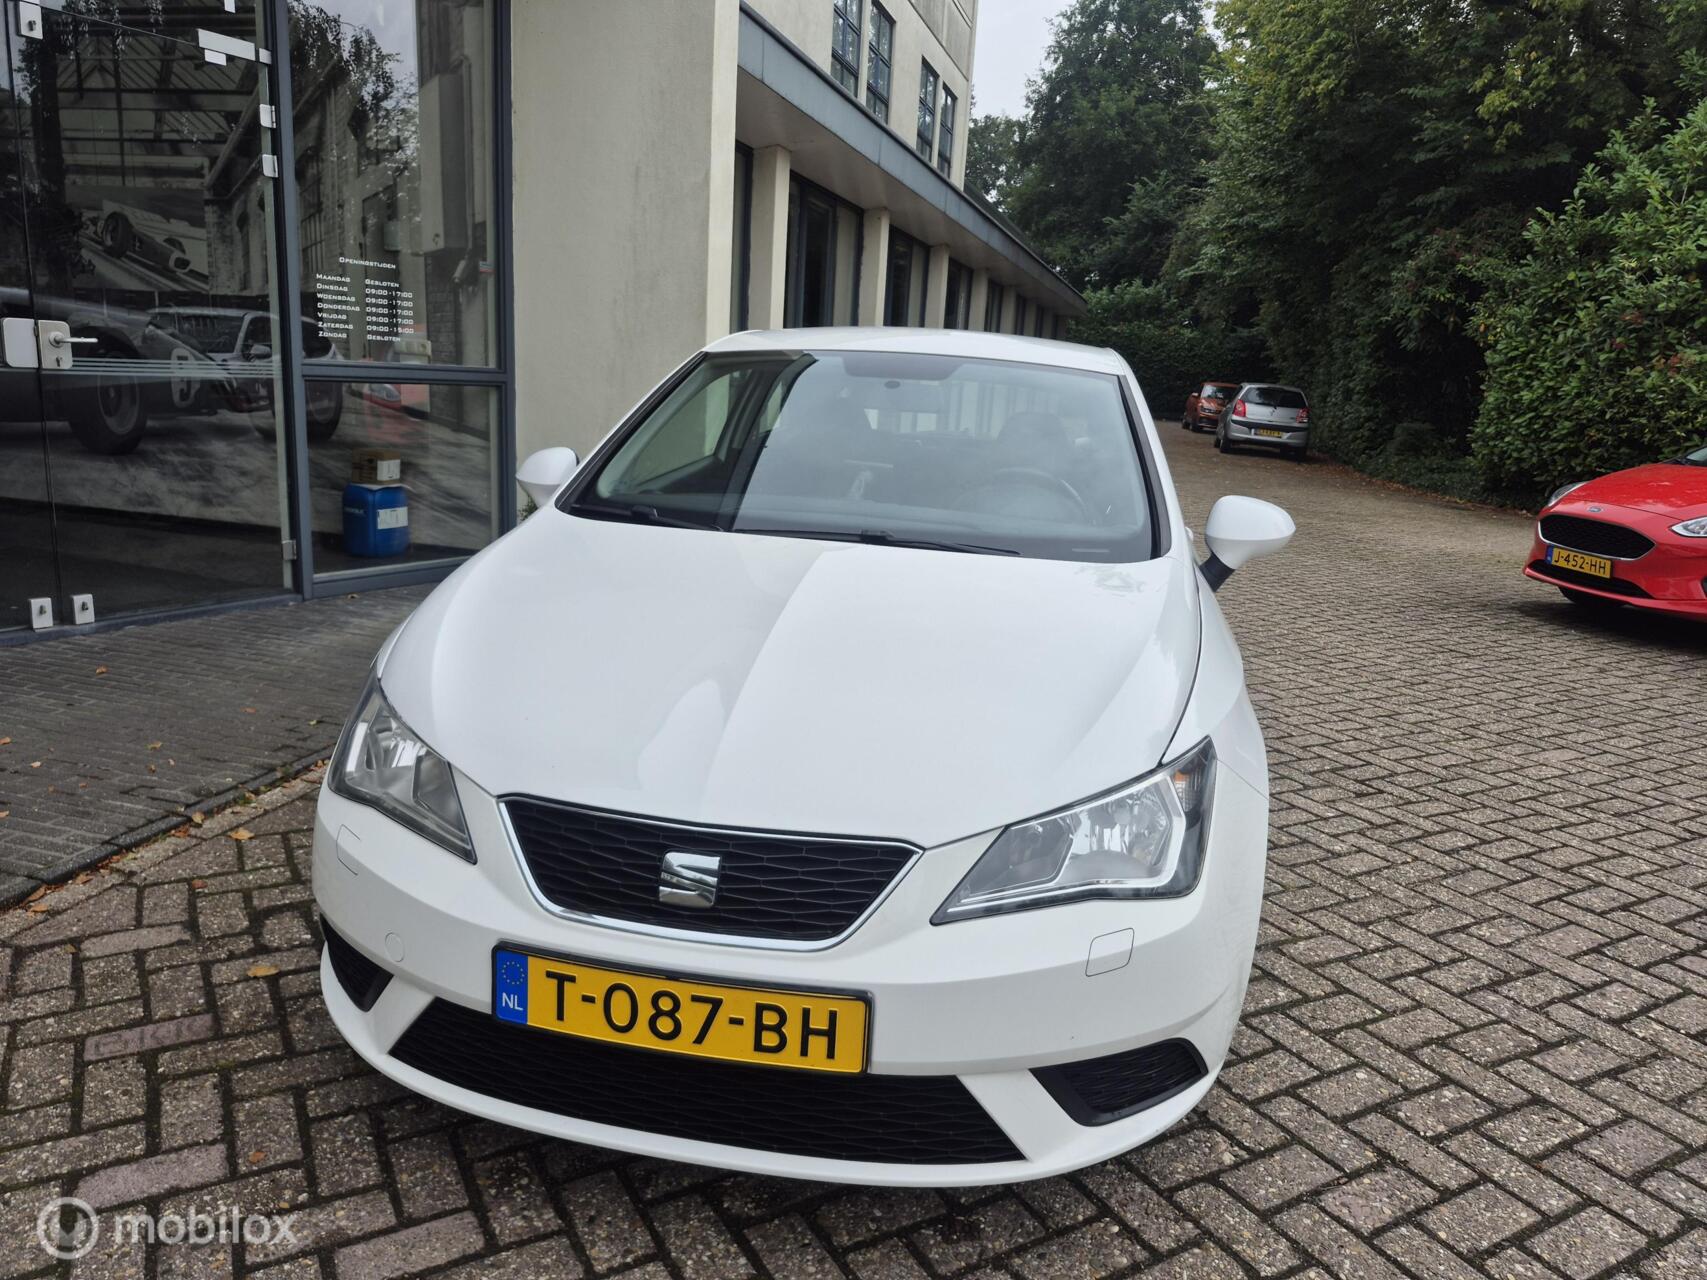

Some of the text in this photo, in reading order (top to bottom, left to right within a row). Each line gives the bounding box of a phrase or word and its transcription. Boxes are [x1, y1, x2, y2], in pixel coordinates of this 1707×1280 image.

[1554, 551, 1606, 575] J-452-HH
[502, 970, 837, 1059] NL T-087-BH
